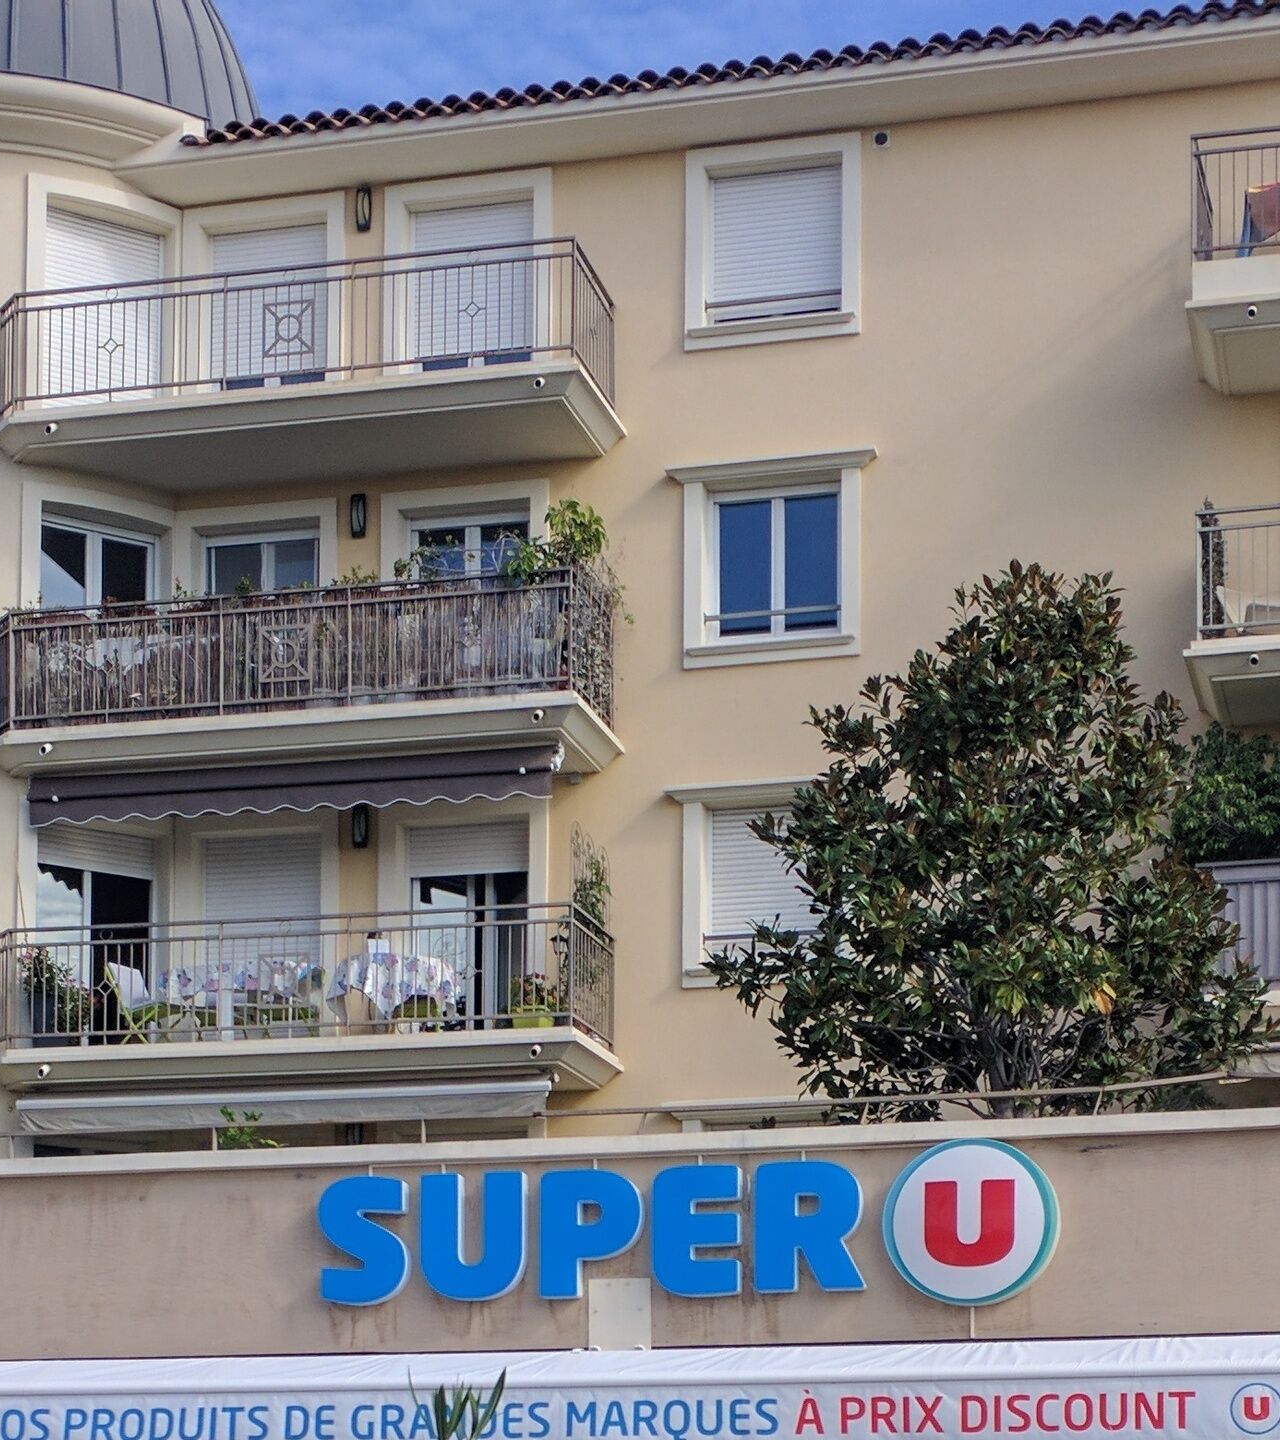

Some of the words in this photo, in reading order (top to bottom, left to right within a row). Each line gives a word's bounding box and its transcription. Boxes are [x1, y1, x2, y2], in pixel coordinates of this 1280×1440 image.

[318, 1160, 867, 1306] SUPER
[923, 1179, 1016, 1267] U
[284, 1404, 335, 1440] DE
[795, 1388, 825, 1435] À
[840, 1395, 944, 1434] PRIX
[959, 1390, 1196, 1433] DISCOUNT
[1243, 1395, 1271, 1421] U
